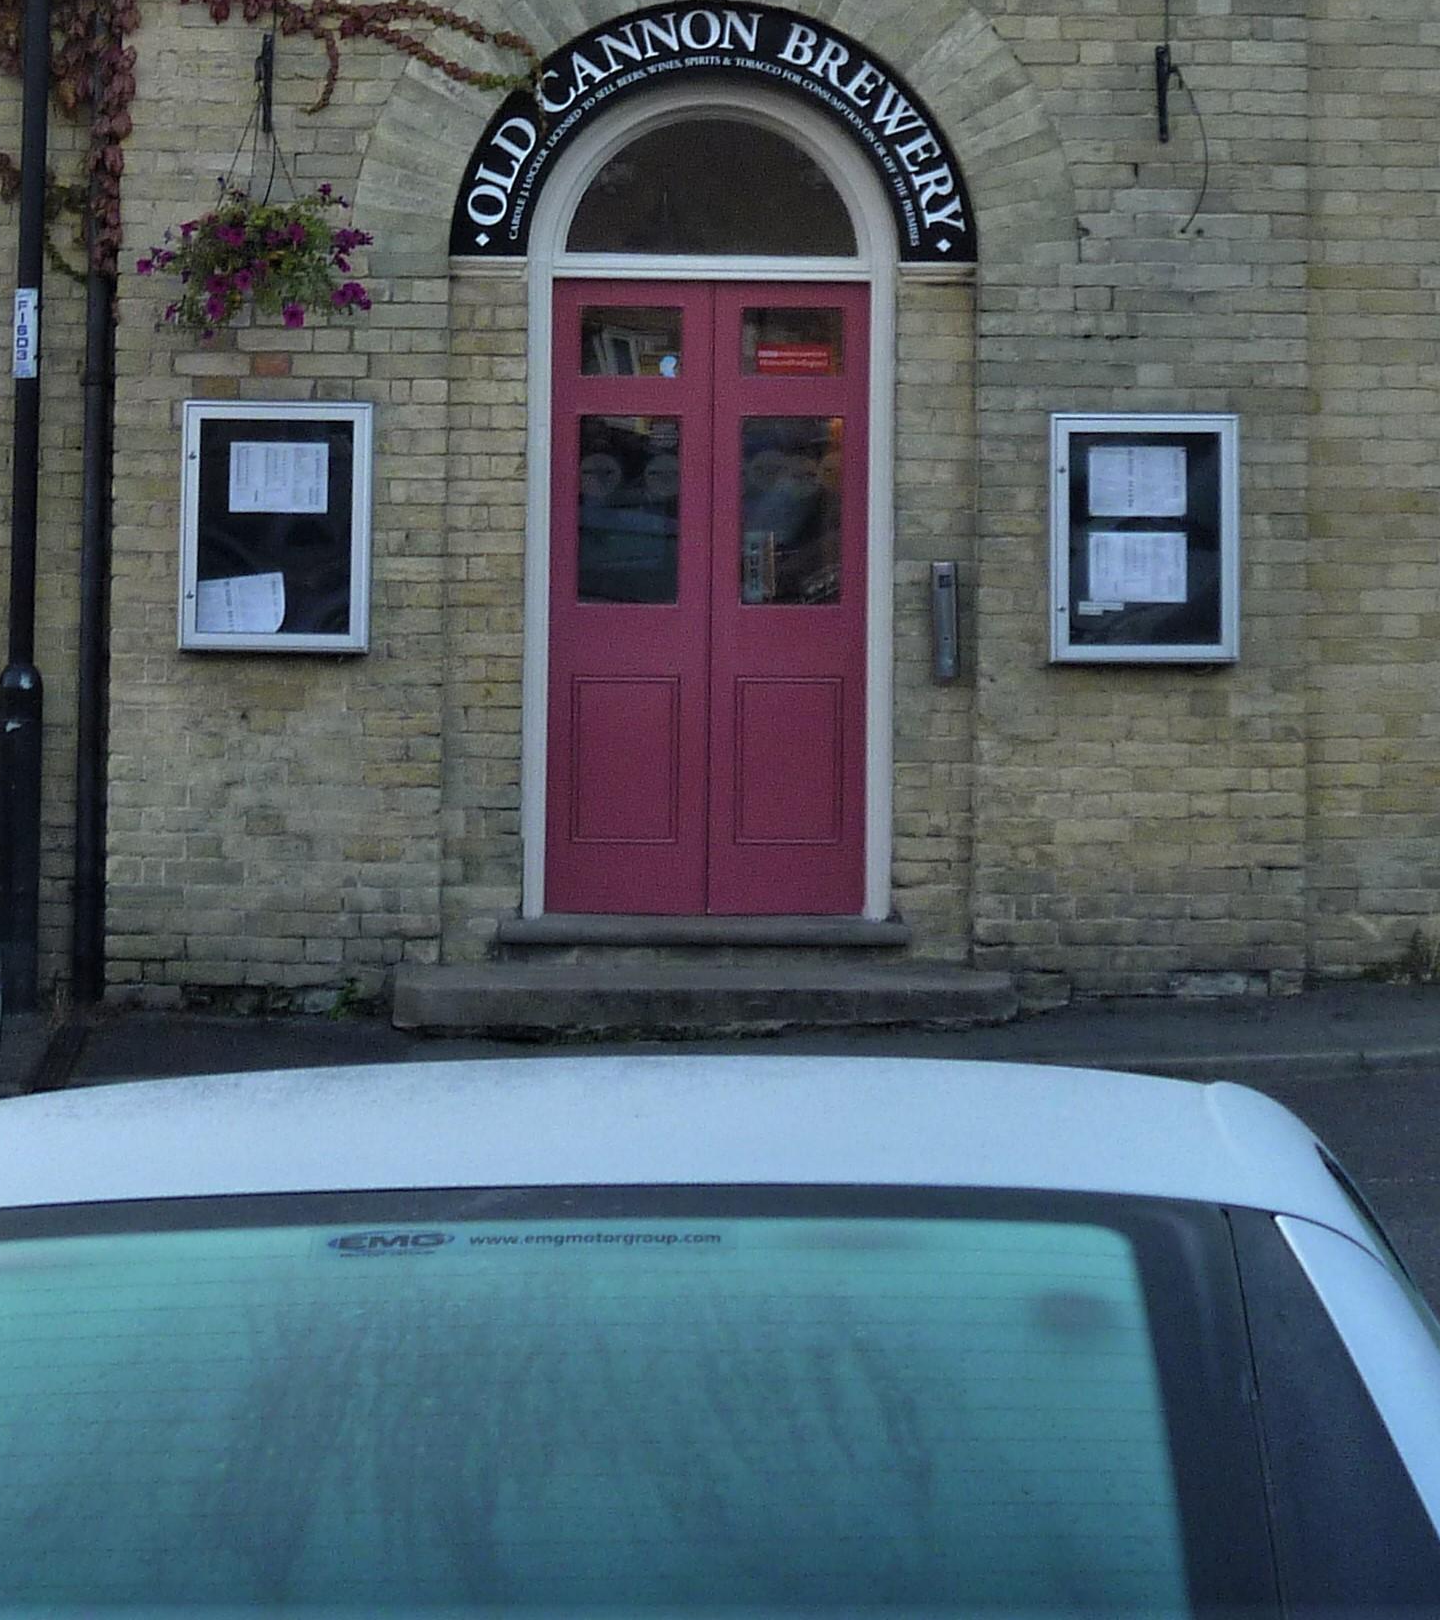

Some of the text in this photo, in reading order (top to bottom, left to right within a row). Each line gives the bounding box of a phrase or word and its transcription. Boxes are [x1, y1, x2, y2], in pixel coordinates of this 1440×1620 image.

[468, 10, 964, 232] OLD CANNON BREWERY
[547, 108, 583, 147] LICENSED
[581, 95, 596, 110] TO
[596, 84, 615, 100] SELL
[684, 55, 720, 65] SPIRITS
[723, 55, 731, 64] &
[735, 56, 782, 74] TOBACCO
[783, 69, 803, 83] FOR
[803, 79, 864, 128] CONSUMPTION
[862, 126, 876, 142] ON
[874, 141, 888, 157] OR
[884, 156, 898, 174] OFF
[893, 177, 908, 196] THE
[903, 199, 918, 246] PREMISES
[468, 1229, 723, 1249] www.emgmotorgroup.com
